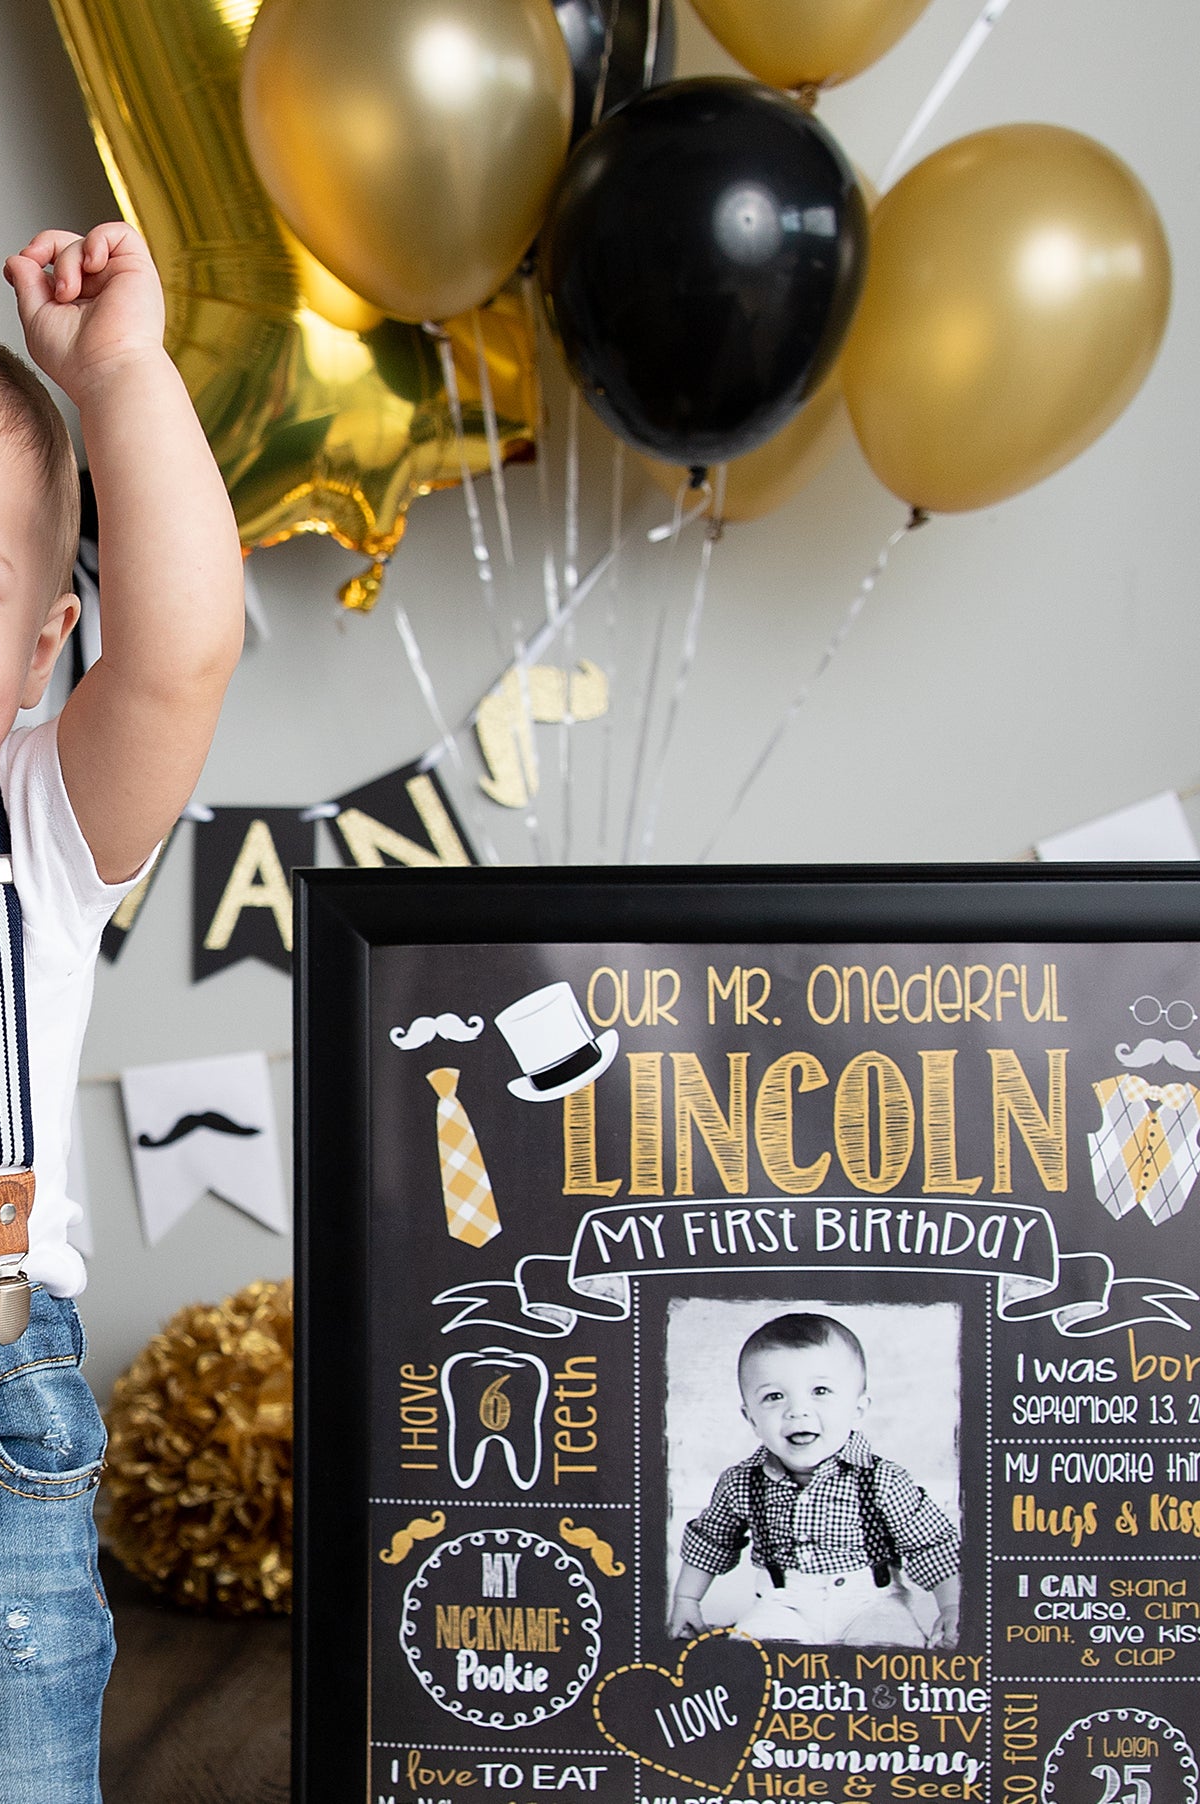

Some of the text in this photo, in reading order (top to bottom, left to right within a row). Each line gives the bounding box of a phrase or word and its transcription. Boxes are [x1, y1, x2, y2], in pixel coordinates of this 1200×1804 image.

[112, 773, 472, 952] AN
[586, 966, 681, 1028] OUR
[708, 966, 781, 1025] MR.
[561, 1048, 1070, 1196] LINCOLN
[1018, 1354, 1024, 1382] I
[1034, 1358, 1117, 1382] was
[479, 1374, 510, 1431] 6
[554, 1357, 597, 1485] Teeth
[1013, 1495, 1097, 1547] Hugs
[1116, 1501, 1138, 1536] &
[482, 1553, 521, 1598] MY
[1019, 1575, 1028, 1597] I
[1040, 1575, 1097, 1597] CAN
[435, 1604, 570, 1653] NICKNAME:
[456, 1649, 549, 1693] Pookie
[777, 1653, 842, 1680] MR.
[1081, 1649, 1100, 1666] &
[772, 1680, 989, 1713] bath time
[764, 1714, 982, 1742] ABC Kids TV
[1087, 1736, 1093, 1757] I
[392, 1750, 607, 1790] I love TO EAT
[751, 1739, 985, 1783] Swimming
[747, 1773, 983, 1800] Hide & Seek
